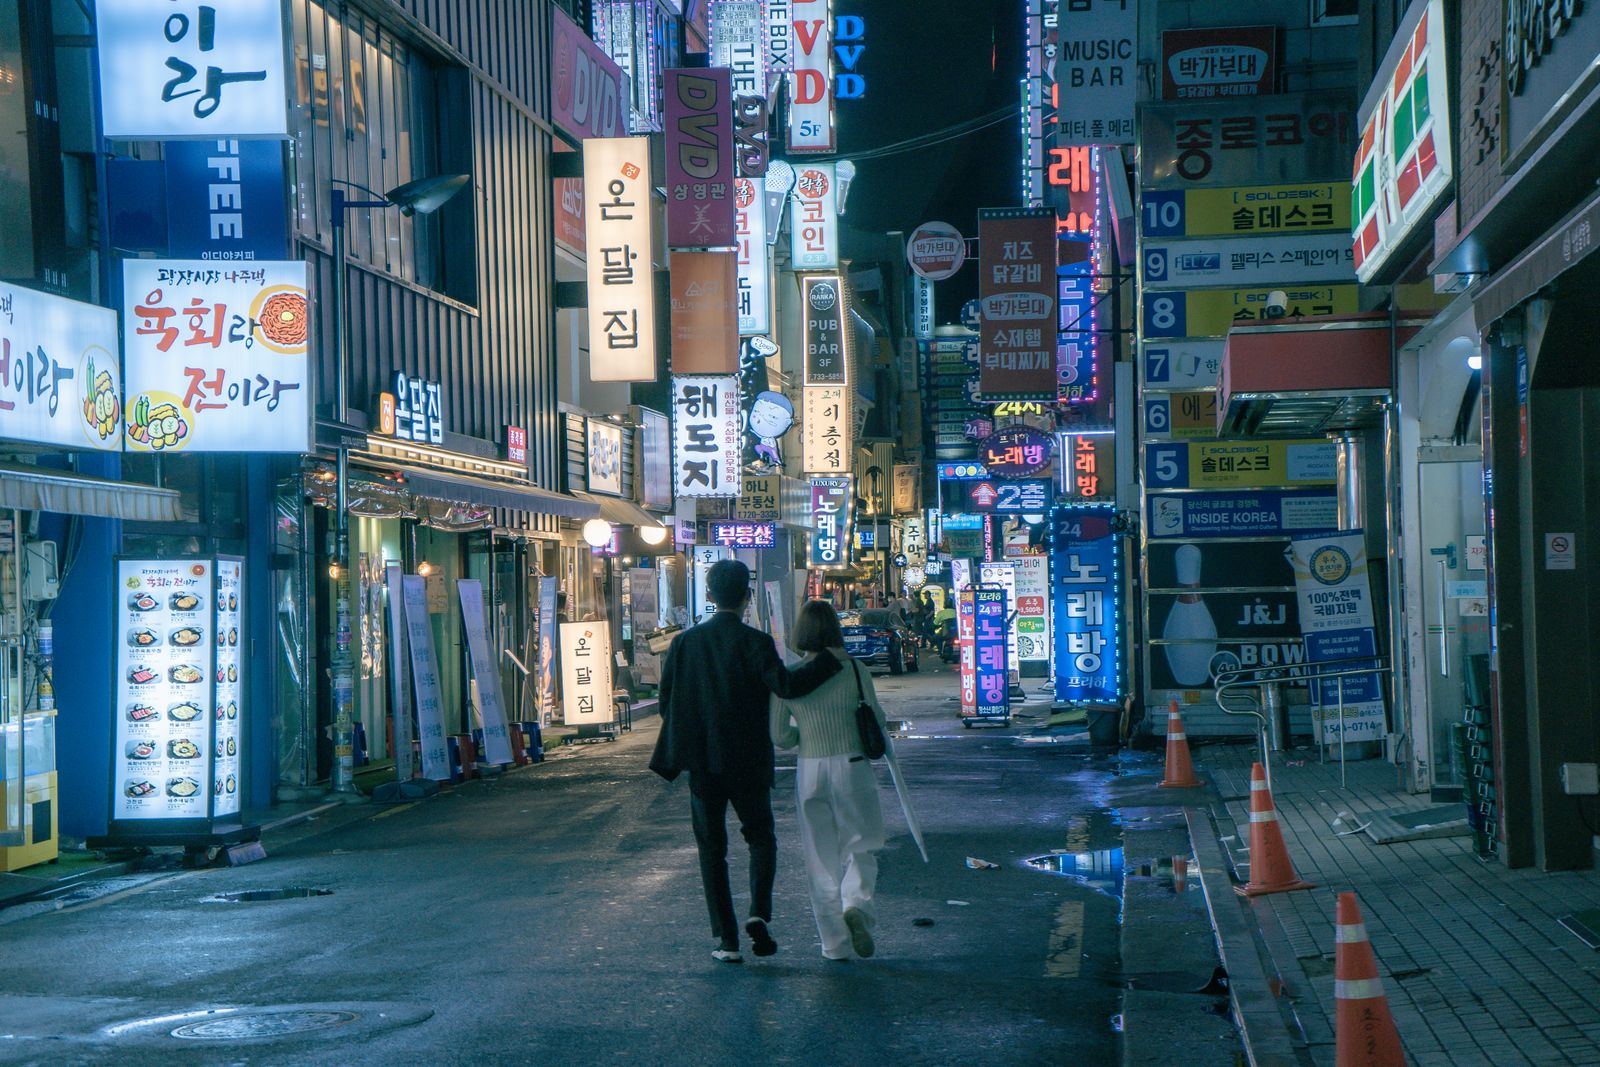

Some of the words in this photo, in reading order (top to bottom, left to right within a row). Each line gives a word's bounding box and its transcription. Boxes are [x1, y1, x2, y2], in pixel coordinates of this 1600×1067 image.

[771, 25, 788, 65] BOX
[792, 0, 827, 105] VD
[834, 15, 866, 99] DVD
[1063, 38, 1133, 62] MUSIC
[733, 43, 755, 91] THE
[1071, 66, 1124, 88] BAR
[1179, 54, 1256, 78] 박가부대
[572, 46, 617, 138] DVD
[677, 74, 720, 180] DVD
[799, 121, 822, 138] 5F
[673, 183, 727, 201] 상영관
[690, 203, 714, 235] 美
[801, 200, 826, 252] 코인
[1145, 201, 1181, 228] 10
[1231, 203, 1334, 231] 솔데스크
[201, 250, 256, 260] 이디야커피
[915, 240, 954, 254] 박가부대
[1002, 241, 1033, 260] 치즈
[1279, 248, 1339, 267] 스페인어
[598, 178, 639, 350] 온달집
[992, 263, 1042, 284] 닭갈비
[1147, 252, 1165, 278] 9
[157, 268, 221, 286] 광장시장
[988, 298, 1046, 317] 박가부대
[1151, 297, 1177, 329] 8
[134, 288, 263, 353] 육회랑
[808, 319, 839, 331] PUB
[820, 332, 827, 341] &
[992, 328, 1042, 348] 수제햄
[808, 343, 839, 355] BAR
[984, 351, 1050, 370] 부대찌개
[818, 358, 832, 367] 3F
[1149, 354, 1166, 378] 7
[183, 366, 300, 414] 전이랑
[394, 372, 444, 445] 온달집
[1149, 403, 1166, 428] 6
[677, 383, 719, 490] 해도지
[822, 403, 842, 468] 이층집
[966, 423, 978, 436] 24
[988, 444, 1044, 465] 노래방
[1075, 435, 1099, 497] 노래방
[1155, 449, 1178, 481] 5
[1201, 456, 1270, 473] 솔데스크
[745, 480, 768, 493] 하나
[996, 483, 1046, 509] 2층
[740, 495, 775, 508] 부동산
[814, 494, 840, 561] 노래방
[1060, 521, 1082, 538] 24
[1188, 512, 1230, 524] INSIDE
[1233, 511, 1278, 523] KOREA
[717, 525, 771, 544] 부동산
[908, 525, 923, 558] 주막
[978, 604, 991, 615] 24
[1061, 553, 1107, 673] 노래방
[1237, 603, 1286, 625] J&J
[1313, 602, 1357, 616] 국비지원
[977, 619, 1005, 703] 노래방
[574, 637, 594, 714] 온달집
[1068, 675, 1107, 688] 프라하
